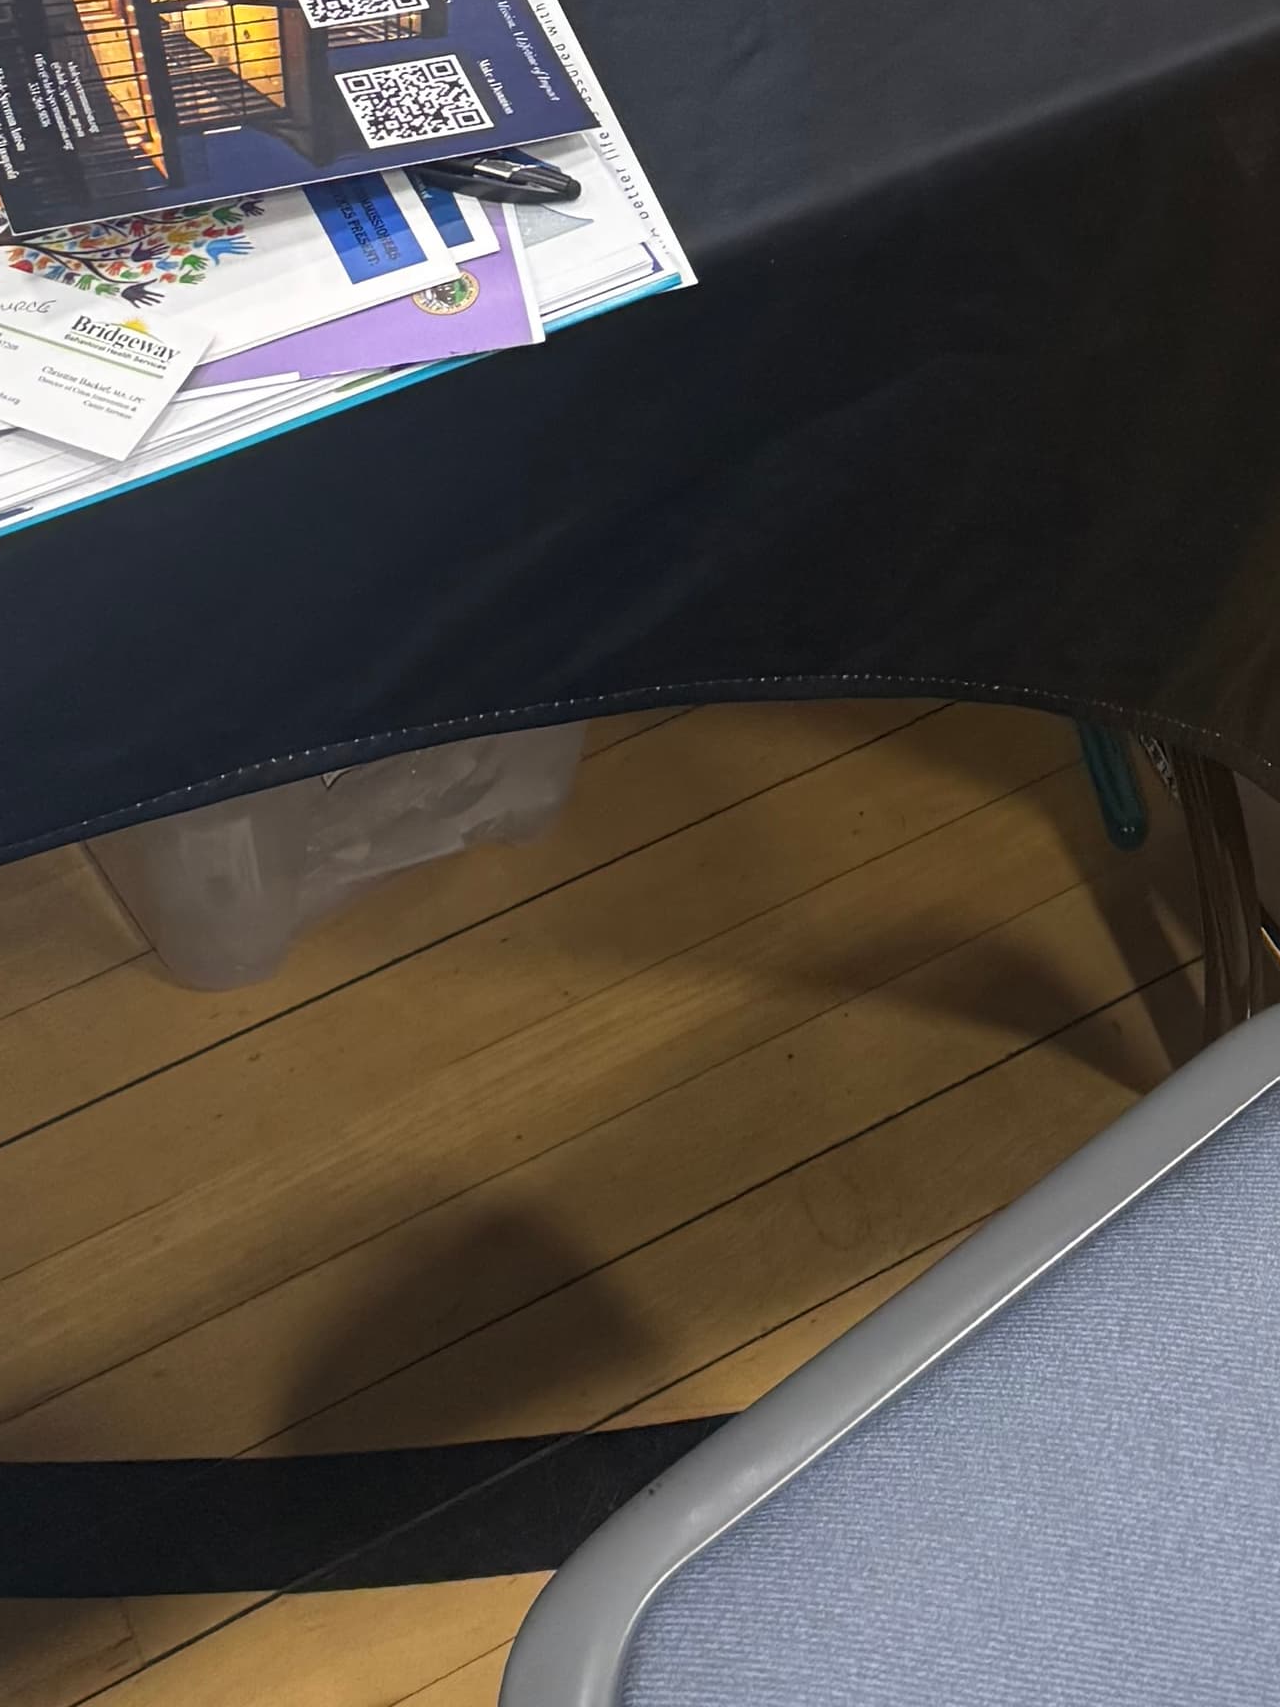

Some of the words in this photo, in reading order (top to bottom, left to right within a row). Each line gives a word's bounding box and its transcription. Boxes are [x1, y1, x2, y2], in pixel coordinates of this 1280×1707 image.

[533, 0, 558, 38] with
[64, 333, 107, 352] Behavioral
[108, 347, 133, 360] Health
[133, 355, 167, 371] Services
[69, 312, 180, 366] Bridgeway
